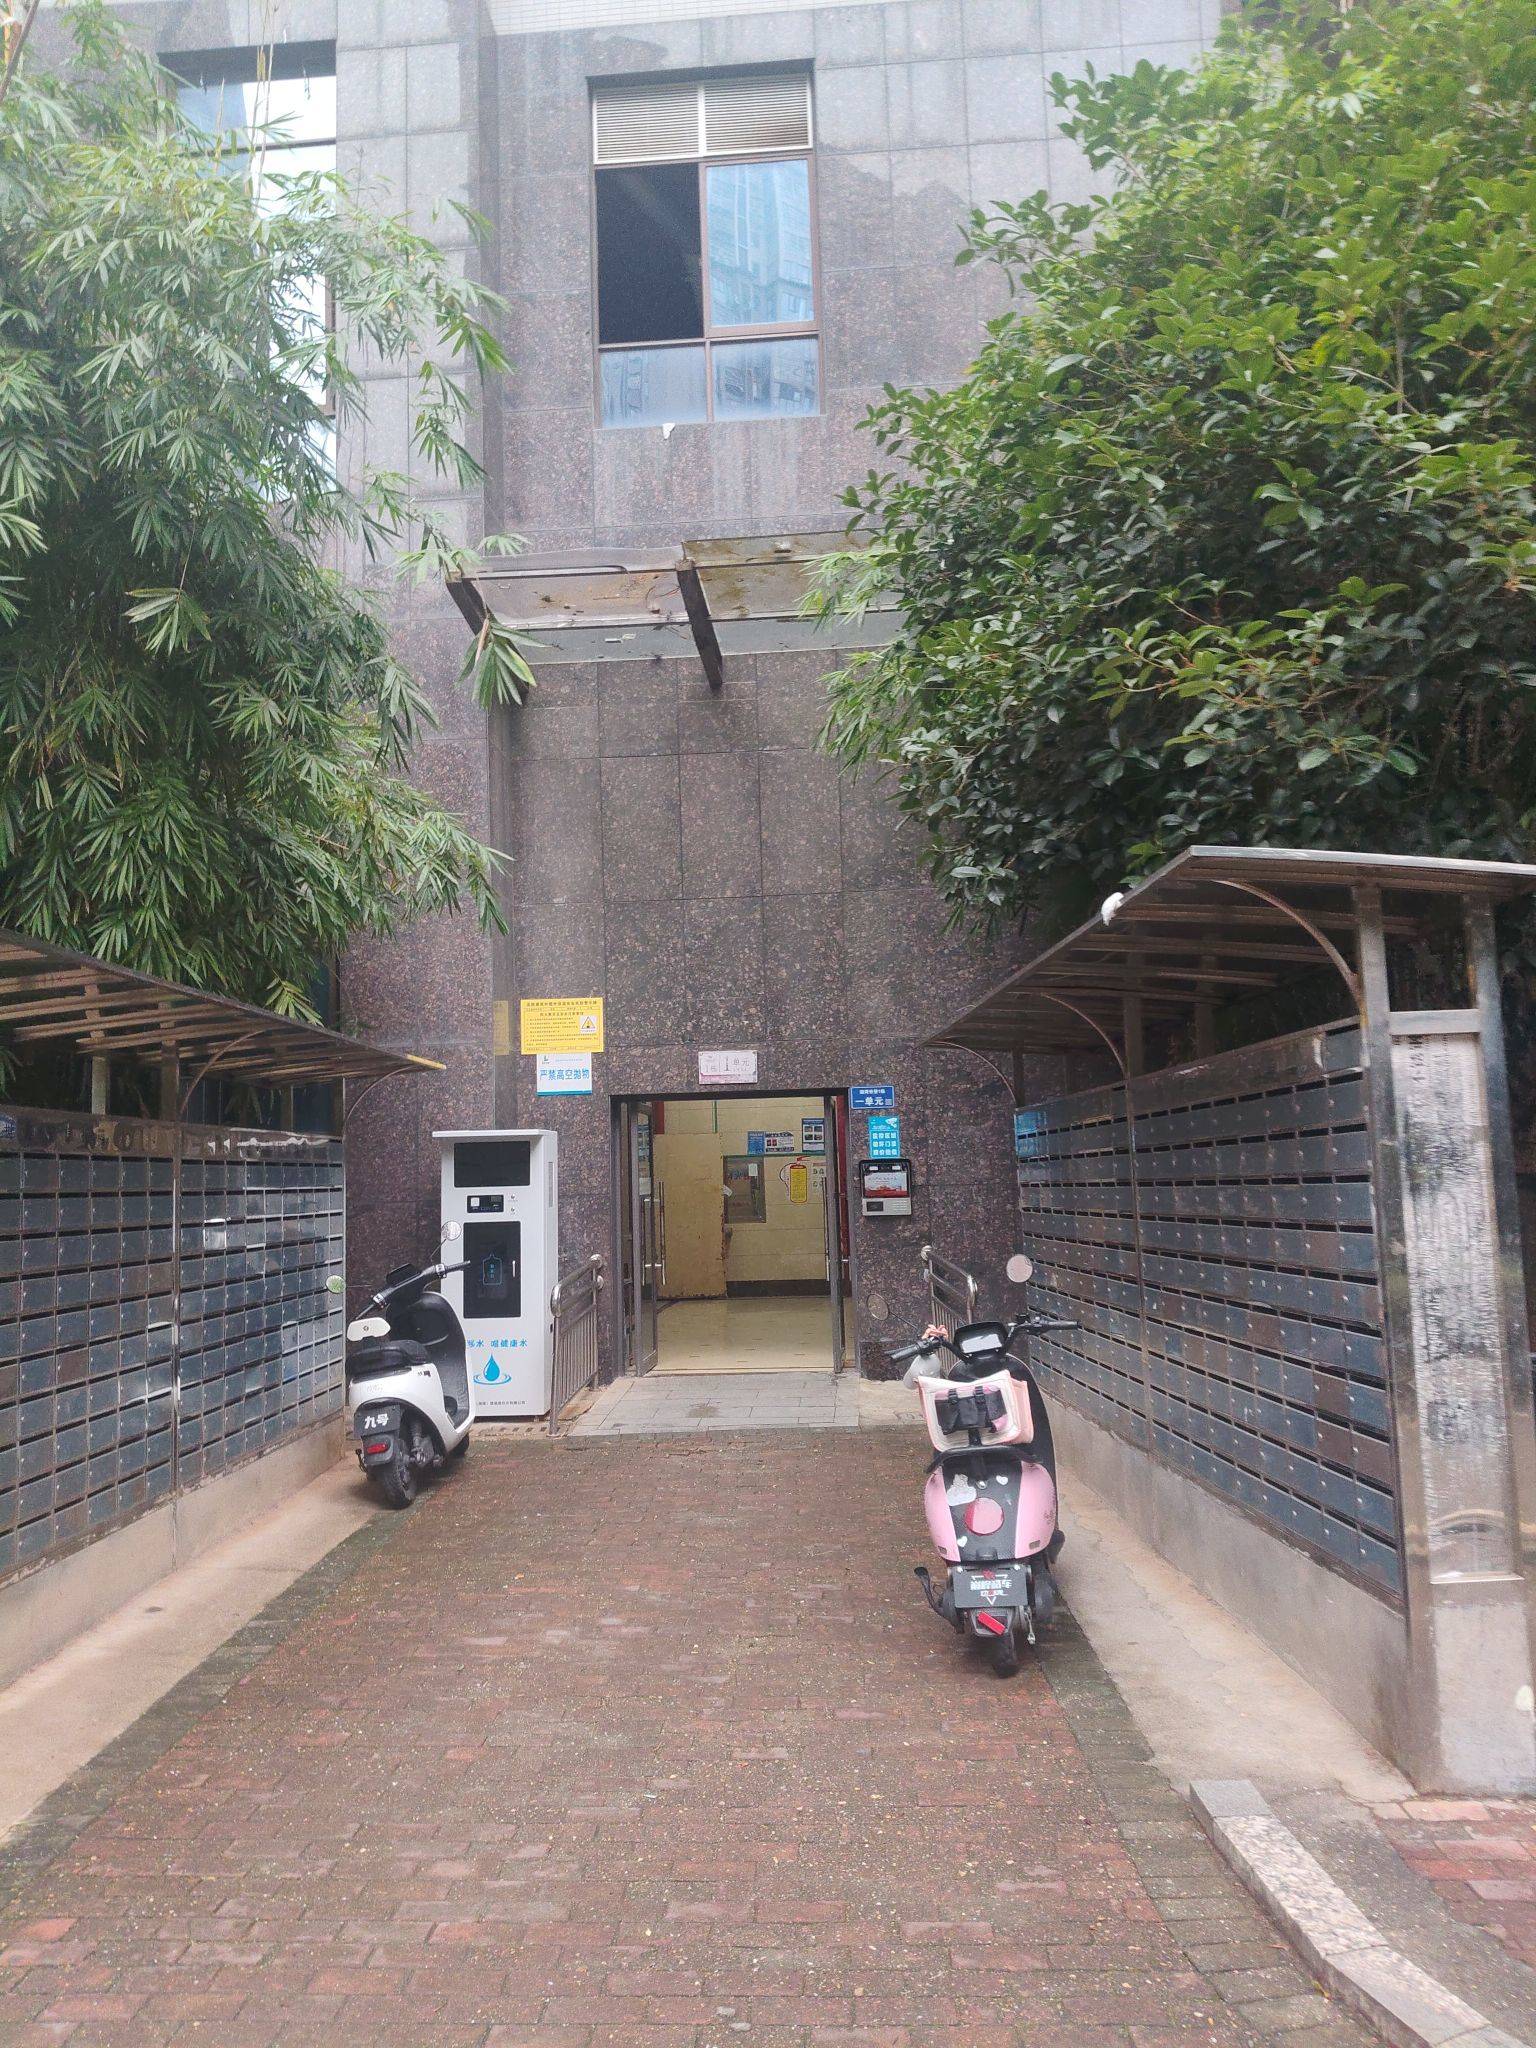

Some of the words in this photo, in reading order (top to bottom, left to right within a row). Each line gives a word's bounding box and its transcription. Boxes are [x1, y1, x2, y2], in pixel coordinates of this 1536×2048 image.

[540, 1069, 590, 1080] 严禁高空抛物
[855, 1097, 884, 1106] 一单元
[364, 1413, 389, 1429] 九号
